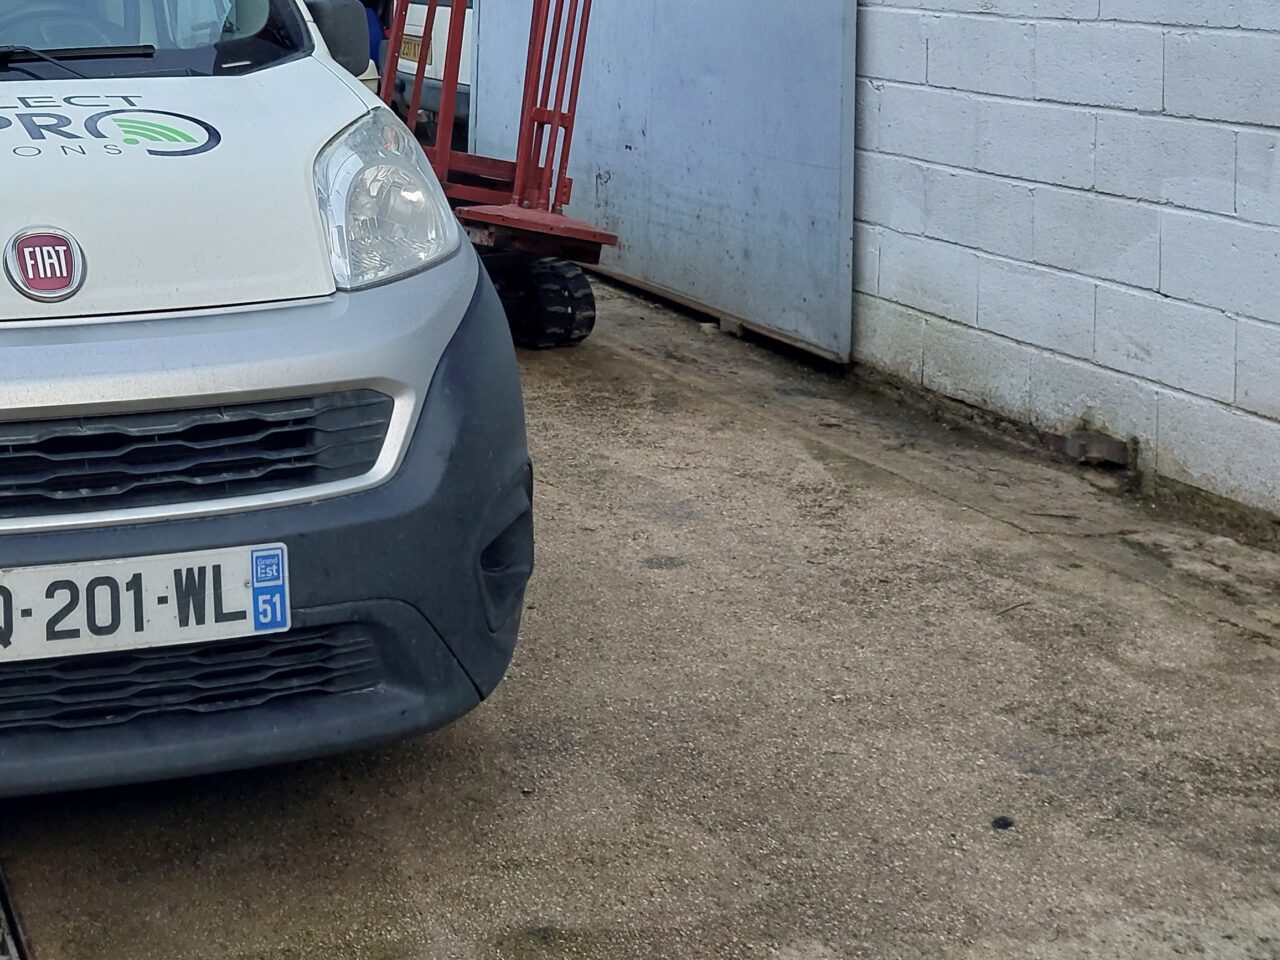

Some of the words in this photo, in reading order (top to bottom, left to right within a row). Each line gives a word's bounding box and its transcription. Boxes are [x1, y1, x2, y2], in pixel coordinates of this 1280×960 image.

[22, 245, 68, 280] FIAT
[257, 564, 278, 578] Est
[258, 593, 282, 624] 51
